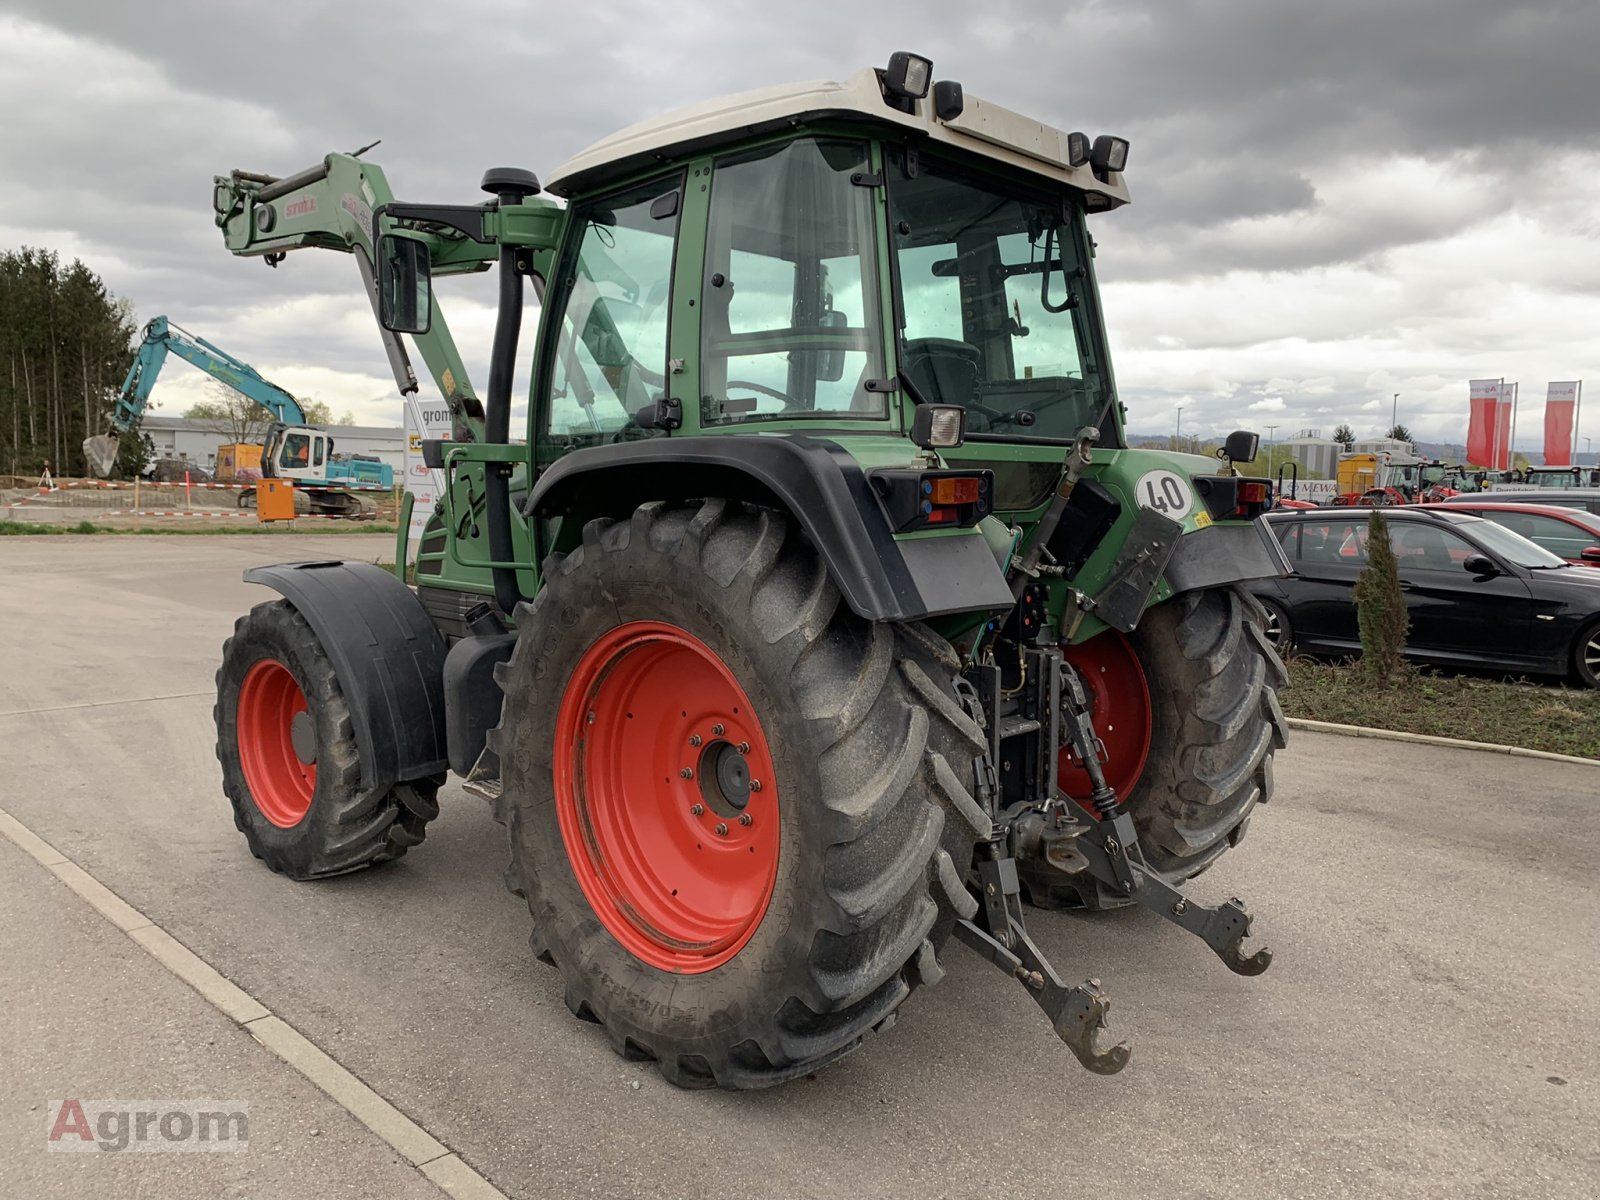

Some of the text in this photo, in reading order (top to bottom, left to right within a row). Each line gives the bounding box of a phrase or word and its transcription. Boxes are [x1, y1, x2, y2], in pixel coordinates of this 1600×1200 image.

[423, 410, 452, 426] grom
[409, 437, 423, 449] JC
[1146, 476, 1185, 513] 40
[1301, 483, 1337, 492] MEWA
